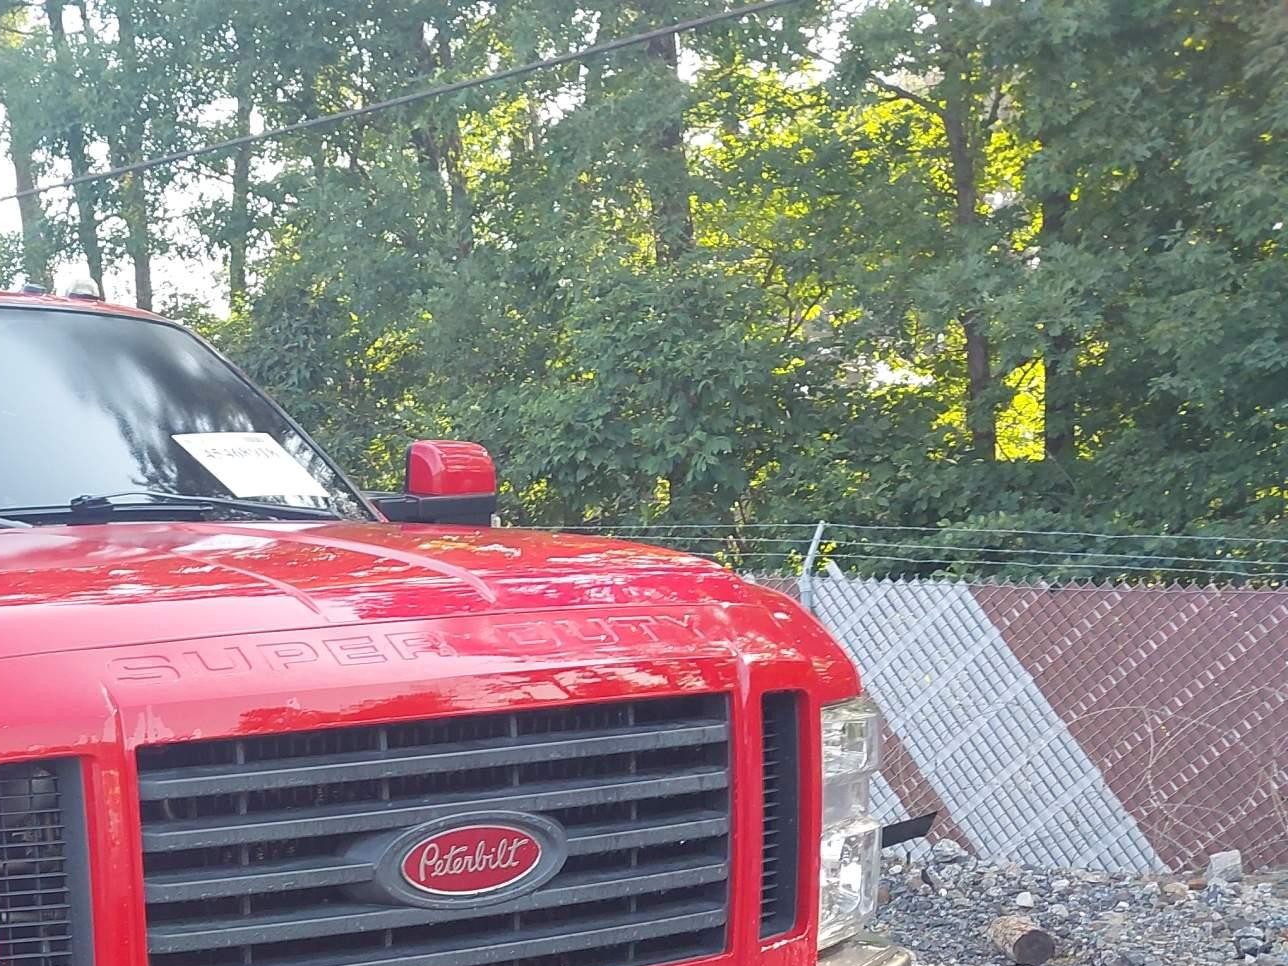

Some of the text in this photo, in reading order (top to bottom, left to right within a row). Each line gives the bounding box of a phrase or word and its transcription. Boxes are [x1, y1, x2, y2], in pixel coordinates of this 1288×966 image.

[106, 612, 705, 683] SUPER DUTY
[419, 838, 530, 882] Peterbilt
